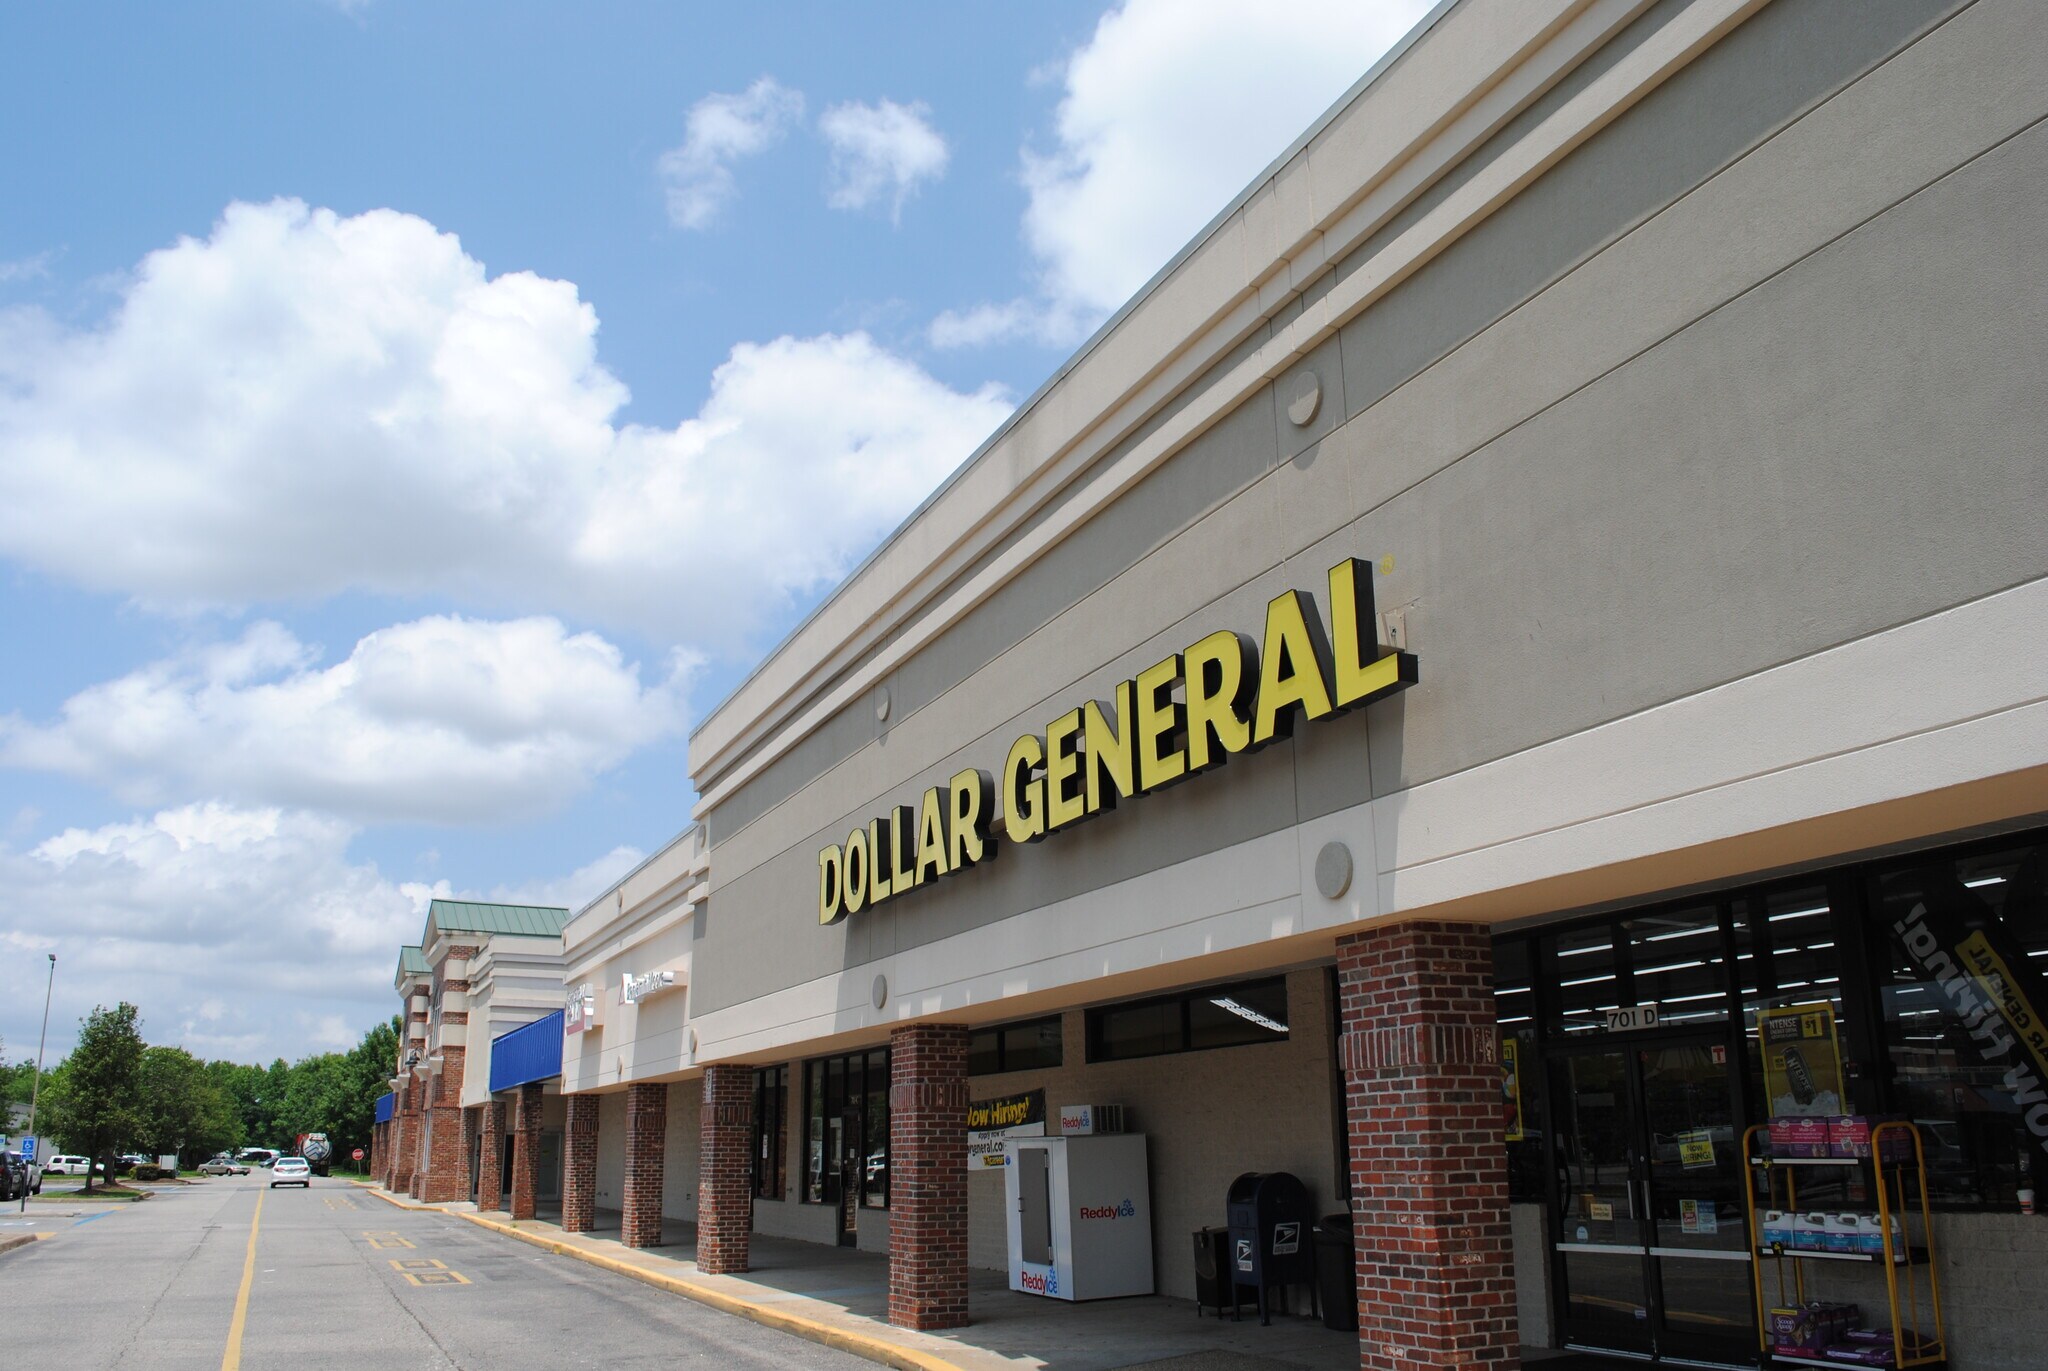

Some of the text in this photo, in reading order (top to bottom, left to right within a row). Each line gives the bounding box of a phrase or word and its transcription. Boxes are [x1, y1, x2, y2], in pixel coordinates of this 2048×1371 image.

[818, 557, 1418, 926] DOLLAR GENERAL
[1608, 1009, 1656, 1028] 701 D
[1769, 1017, 1797, 1030] NTENSE
[1805, 1019, 1817, 1034] $1
[1787, 1057, 1812, 1091] NTENSE
[992, 1096, 1030, 1125] Hiring!
